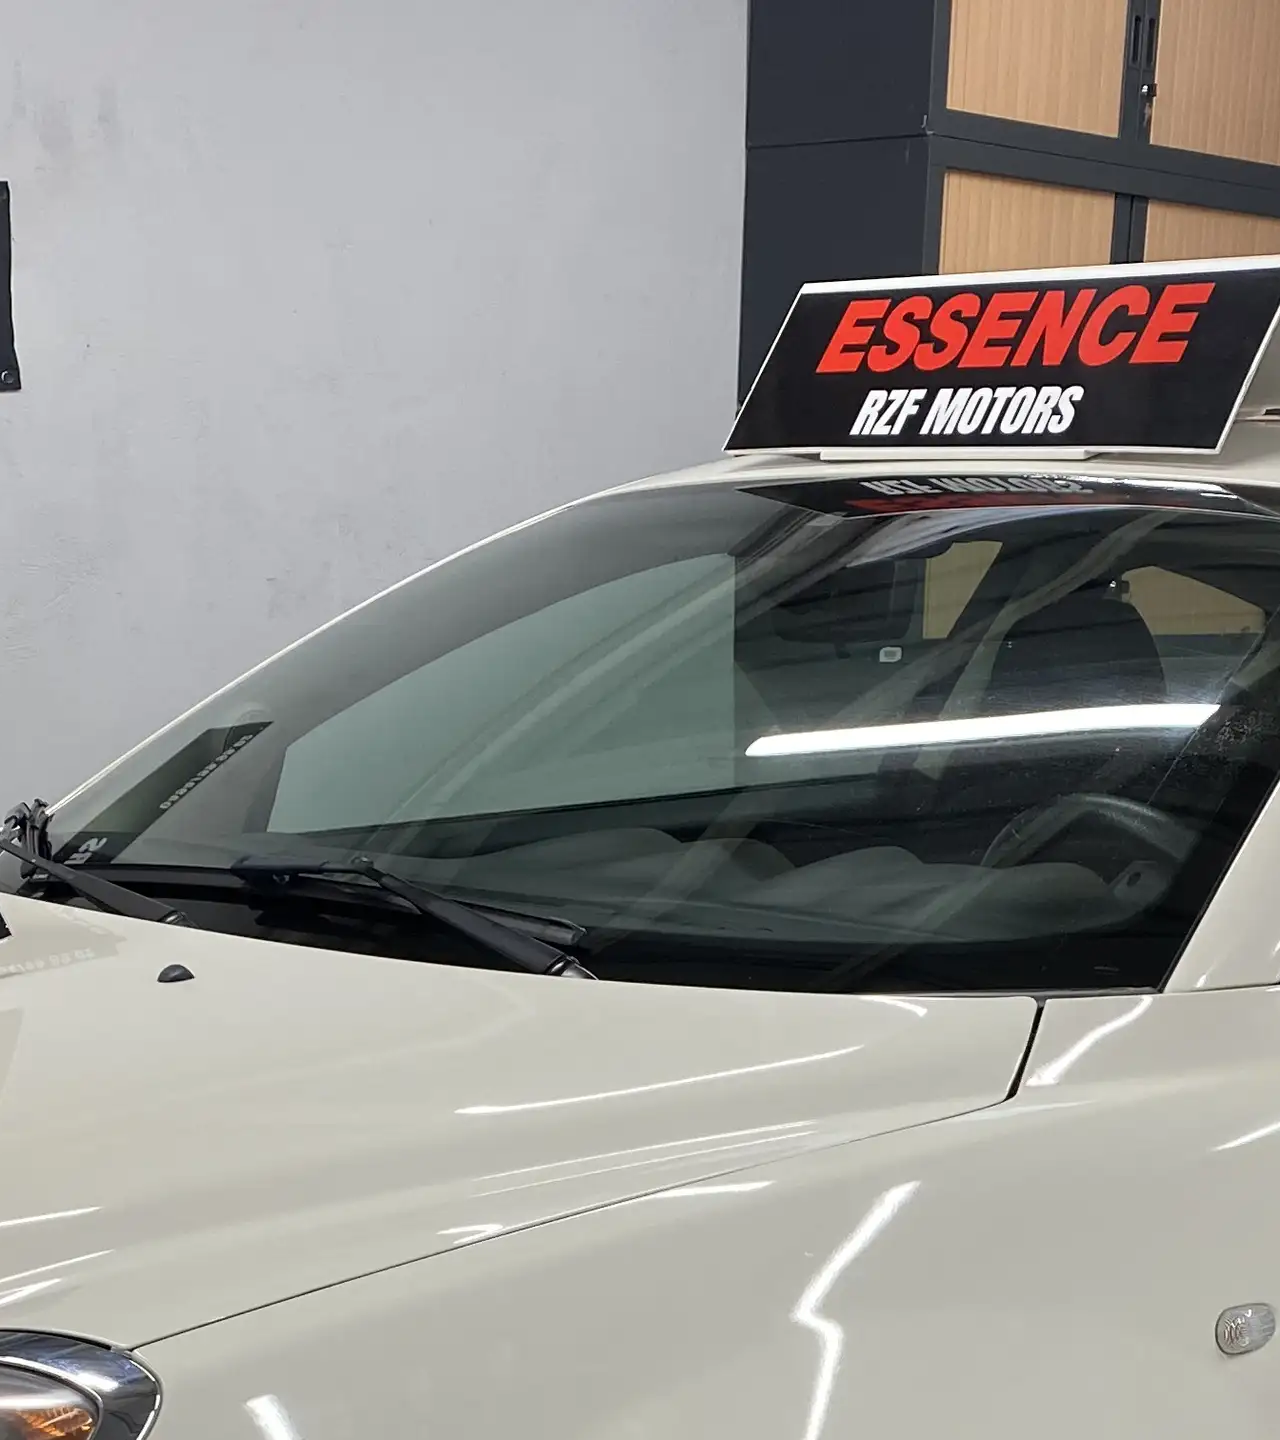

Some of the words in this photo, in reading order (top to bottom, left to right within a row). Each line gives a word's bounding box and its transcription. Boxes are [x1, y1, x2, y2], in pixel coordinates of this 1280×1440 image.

[816, 282, 1217, 374] ESSENCE
[850, 388, 924, 437] RZF
[921, 385, 1086, 435] MOTORS
